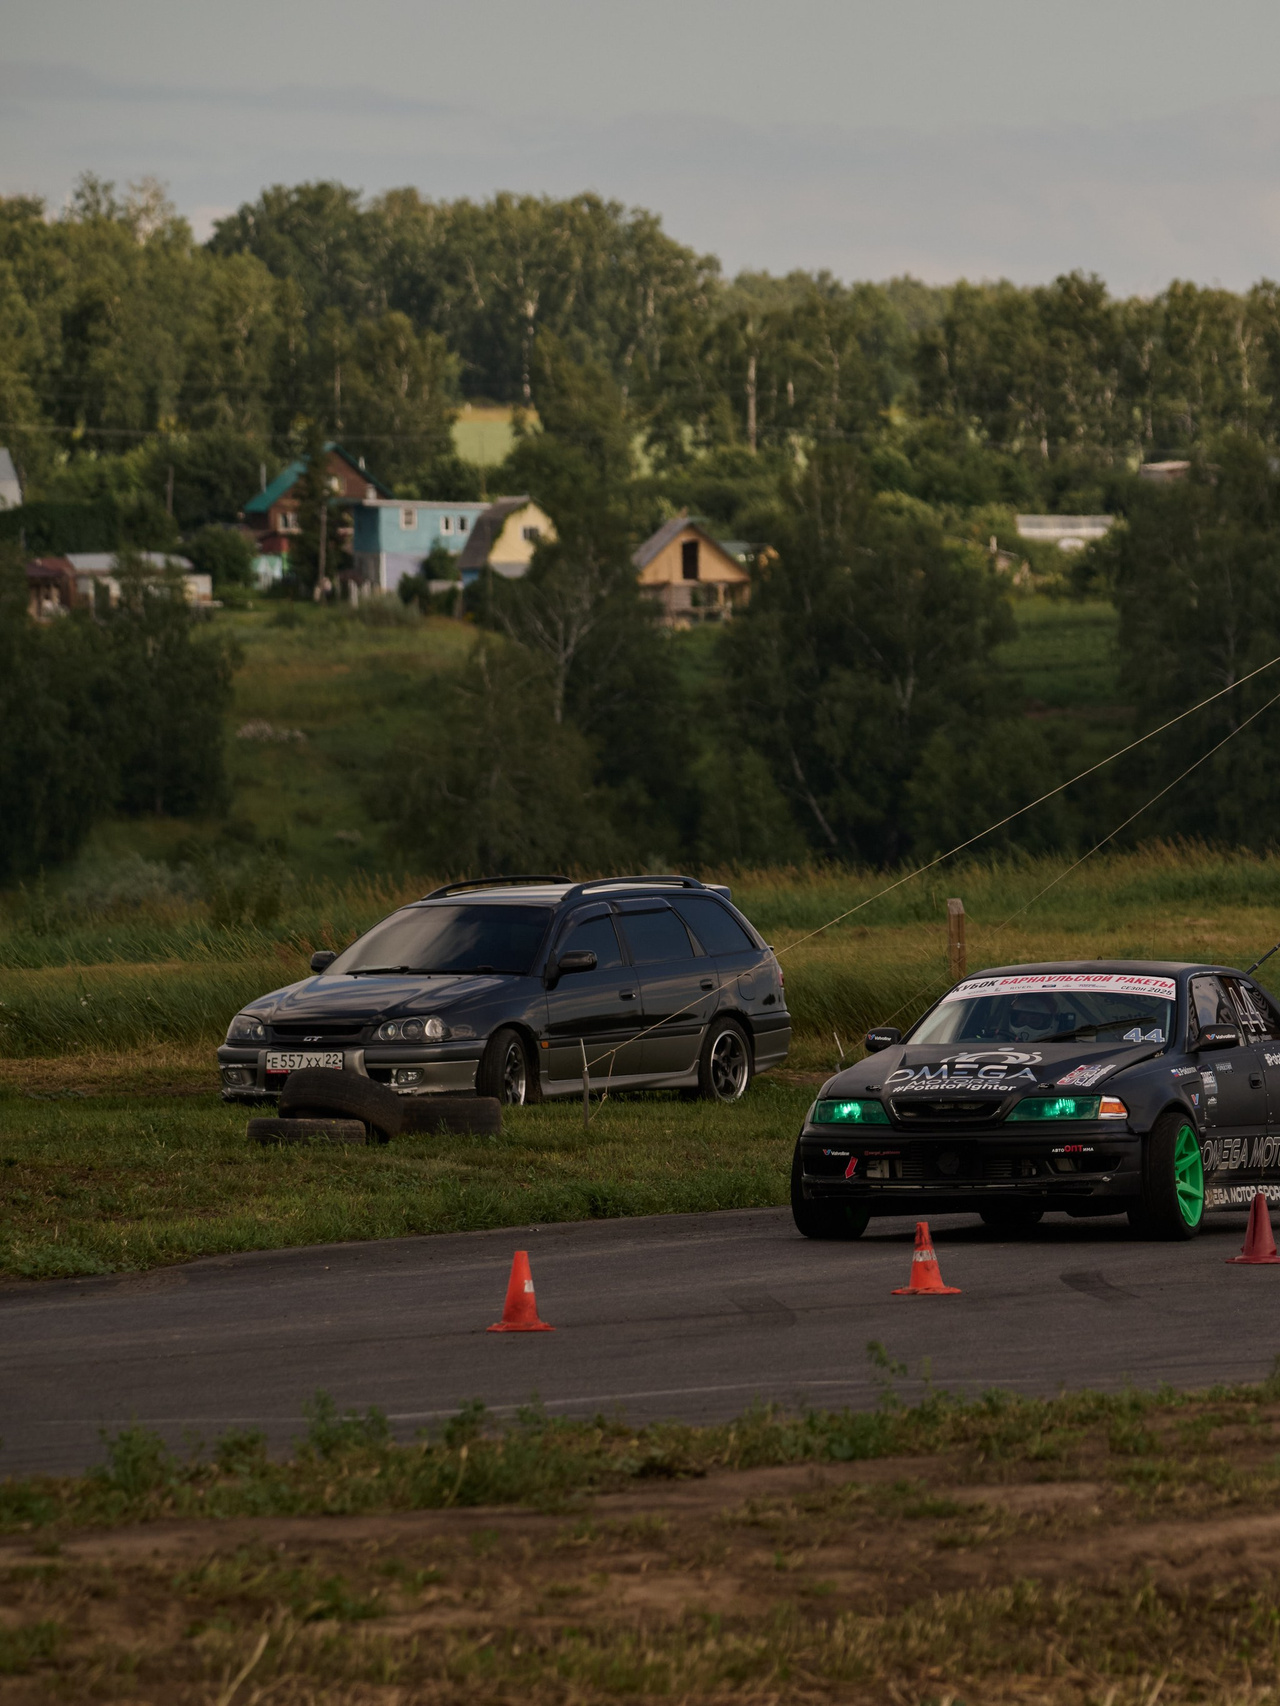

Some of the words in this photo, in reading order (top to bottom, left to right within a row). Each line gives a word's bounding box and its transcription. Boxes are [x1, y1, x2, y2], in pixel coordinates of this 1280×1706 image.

[951, 979, 1001, 994] КУБОК
[1000, 974, 1113, 986] БАРНАУЛЬСКОЙ
[1115, 976, 1176, 989] РАКЕТЫ
[1147, 986, 1174, 995] 2025
[1228, 985, 1268, 1032] 44
[1123, 1027, 1166, 1043] 44
[325, 1053, 339, 1065] 22
[885, 1063, 1038, 1085] OMEGA
[909, 1078, 1001, 1086] MOTORS
[892, 1081, 1017, 1093] #PotatoFighter
[1203, 1138, 1249, 1171] OMEGA
